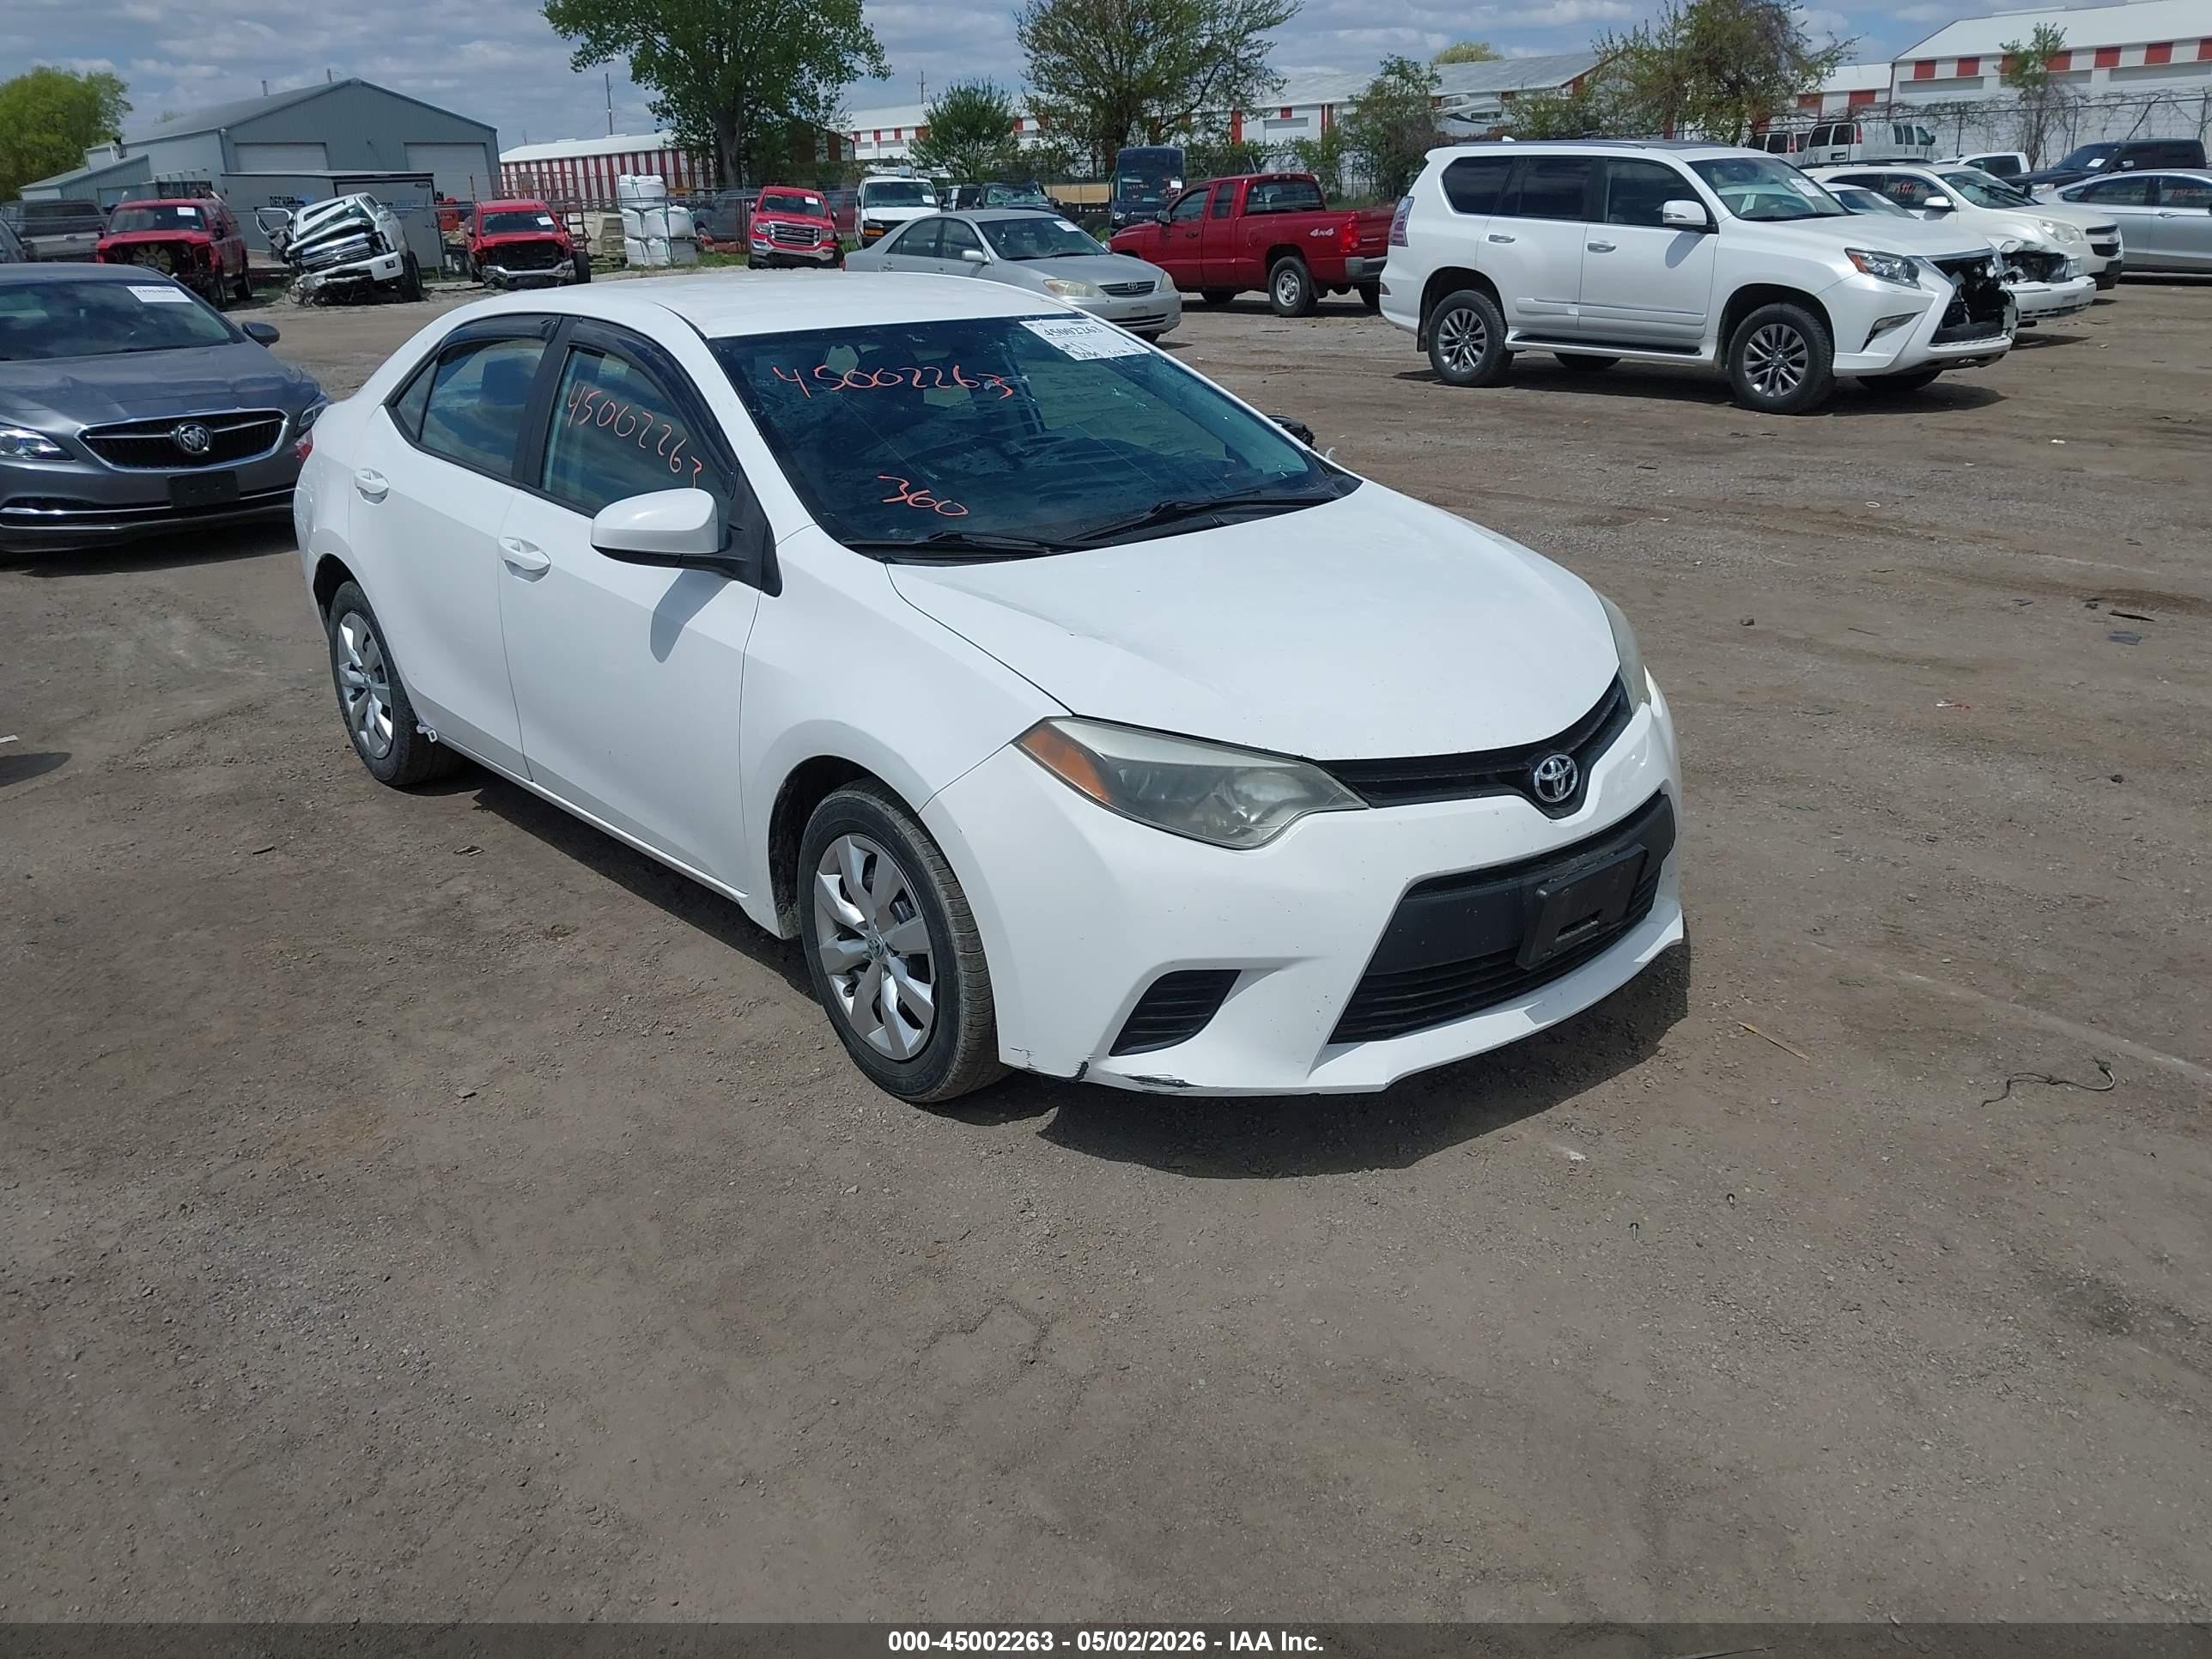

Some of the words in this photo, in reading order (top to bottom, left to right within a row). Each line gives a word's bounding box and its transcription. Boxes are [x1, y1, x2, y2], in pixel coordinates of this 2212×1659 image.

[1310, 228, 1334, 237] 4x4
[772, 364, 1014, 399] 45002263
[877, 475, 969, 516] 360
